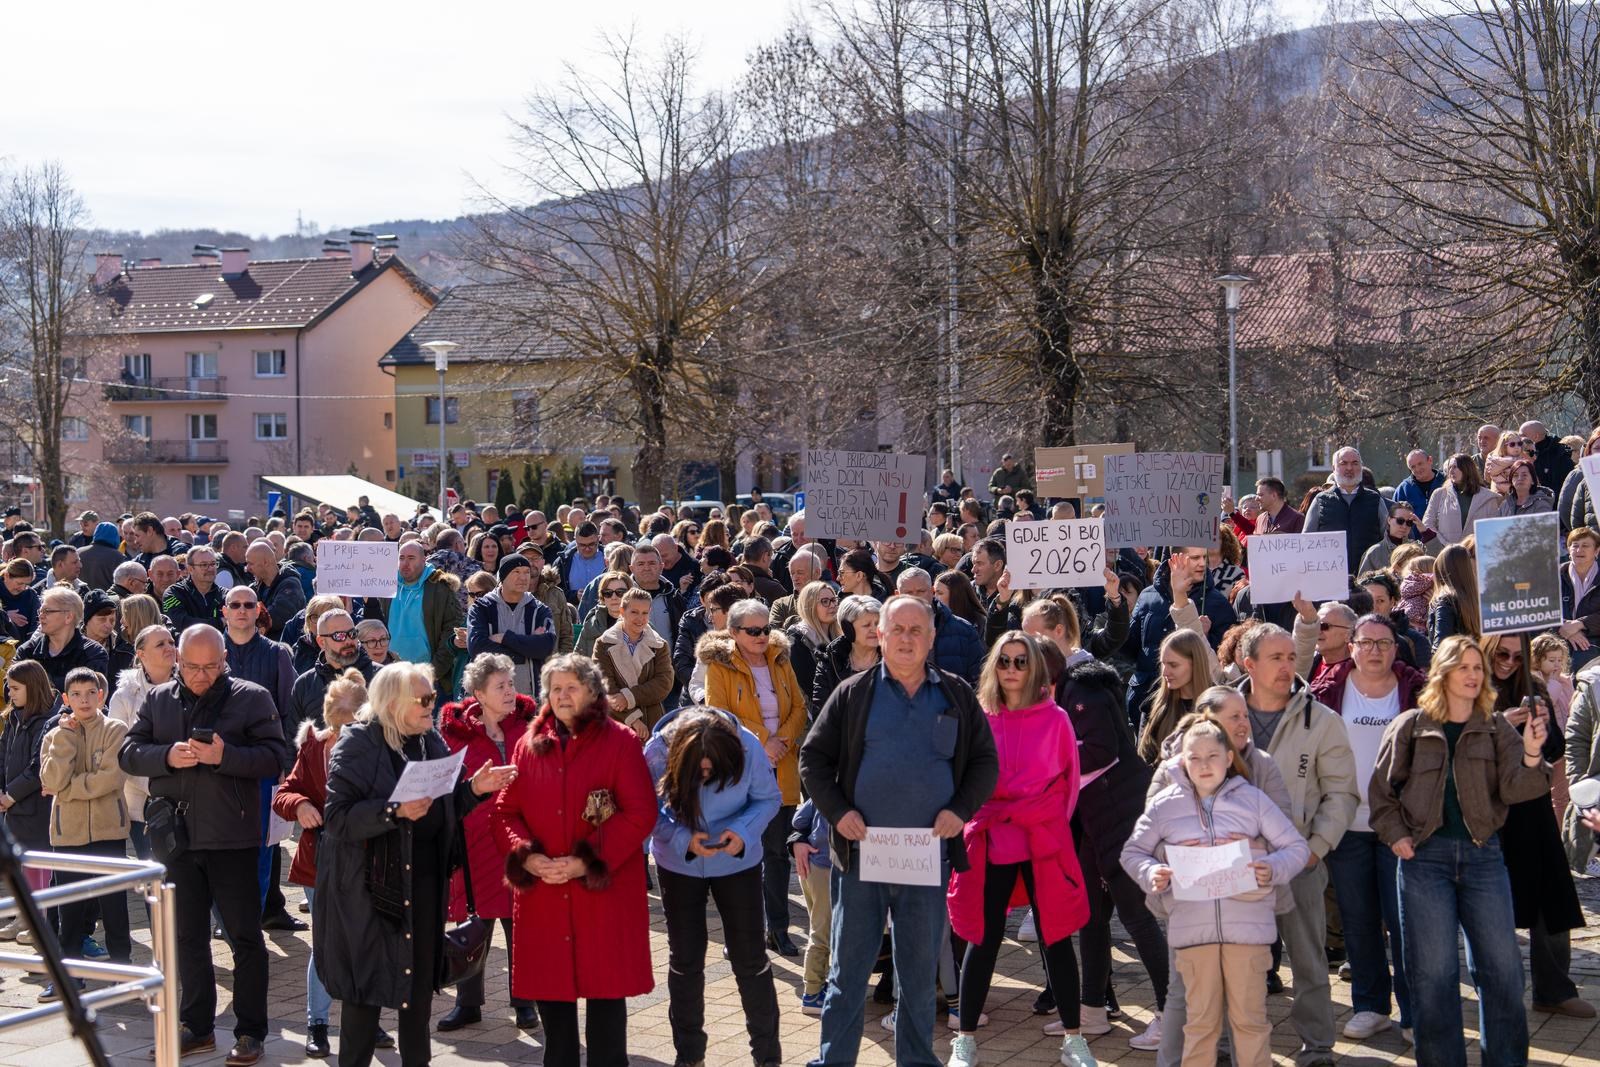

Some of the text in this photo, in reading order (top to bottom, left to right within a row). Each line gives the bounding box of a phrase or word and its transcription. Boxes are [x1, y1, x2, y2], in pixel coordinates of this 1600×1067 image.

[847, 452, 888, 468] PRIRODA
[895, 456, 899, 469] I
[1107, 455, 1126, 474] NE
[837, 469, 864, 486] DOM
[878, 472, 912, 489] NISU
[1166, 472, 1219, 494] IZAZOVE
[1106, 492, 1181, 516] NA RAČUN
[816, 506, 886, 521] GLOBALNIH
[1013, 524, 1100, 544] GDJE SI BIO
[1109, 516, 1218, 542] MALIH SREDINA!
[334, 545, 359, 559] PRIJE
[368, 545, 391, 557] SMO
[1028, 542, 1101, 575] 2026?
[361, 563, 375, 573] DA
[1271, 562, 1288, 575] NE
[327, 579, 352, 589] NISTE
[1490, 597, 1549, 613] NE ODLUCI
[1484, 617, 1504, 629] BEZ
[904, 833, 931, 846] PRAVO
[865, 855, 881, 867] NA
